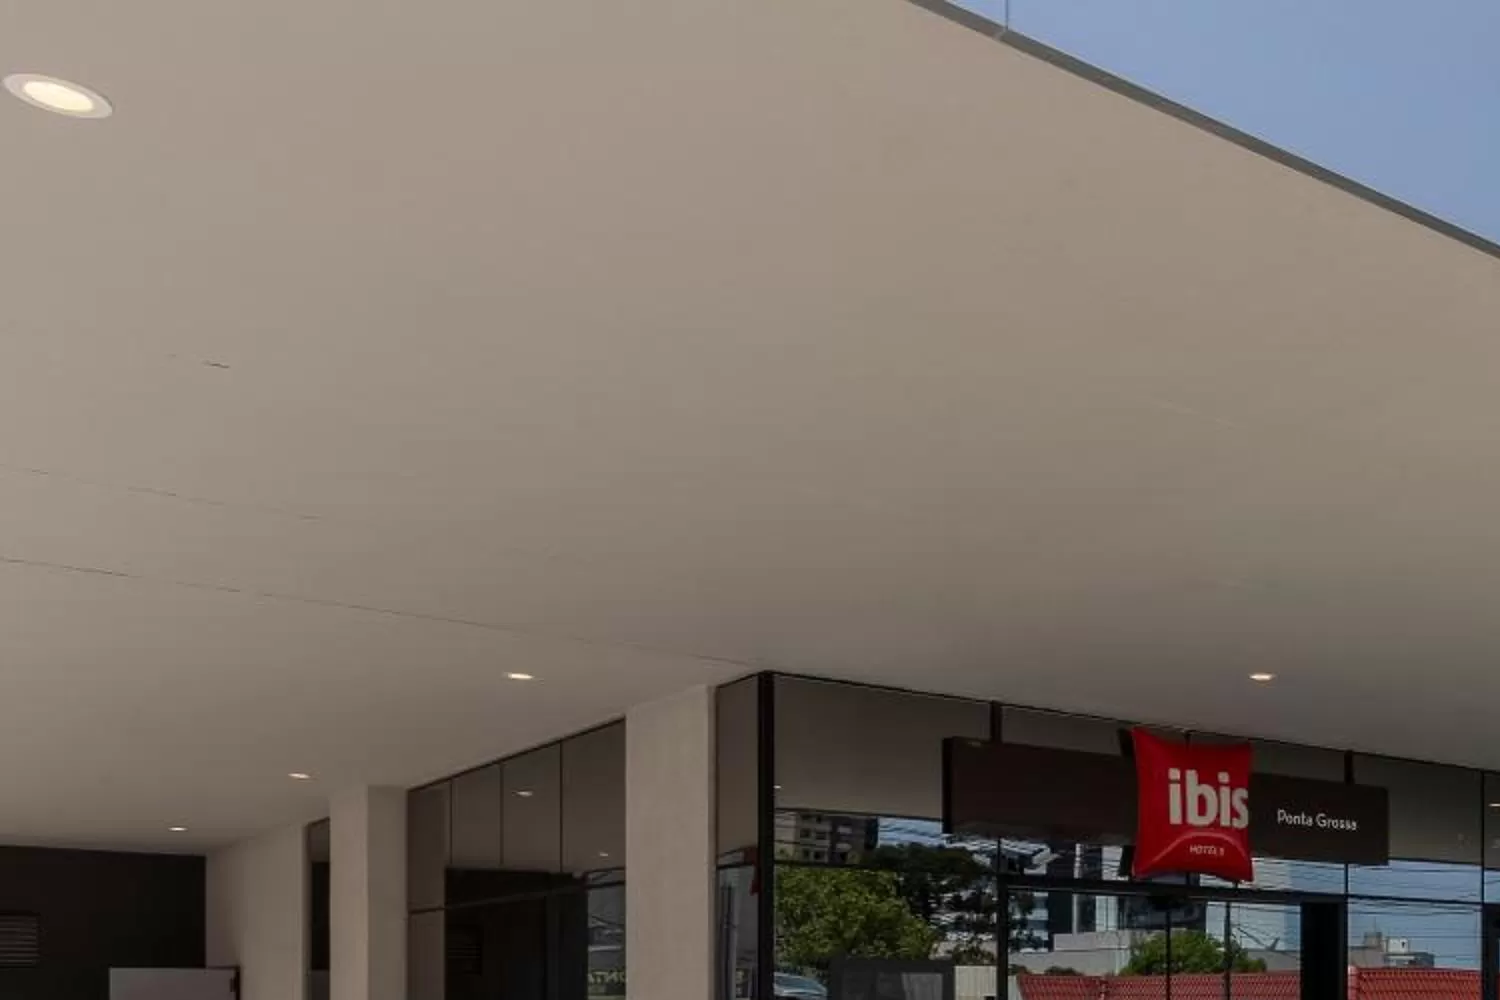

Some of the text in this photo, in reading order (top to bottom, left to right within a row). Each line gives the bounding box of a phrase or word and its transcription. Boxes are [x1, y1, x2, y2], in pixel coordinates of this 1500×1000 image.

[1167, 767, 1249, 829] ibis
[1276, 808, 1357, 831] Ponta Grossa
